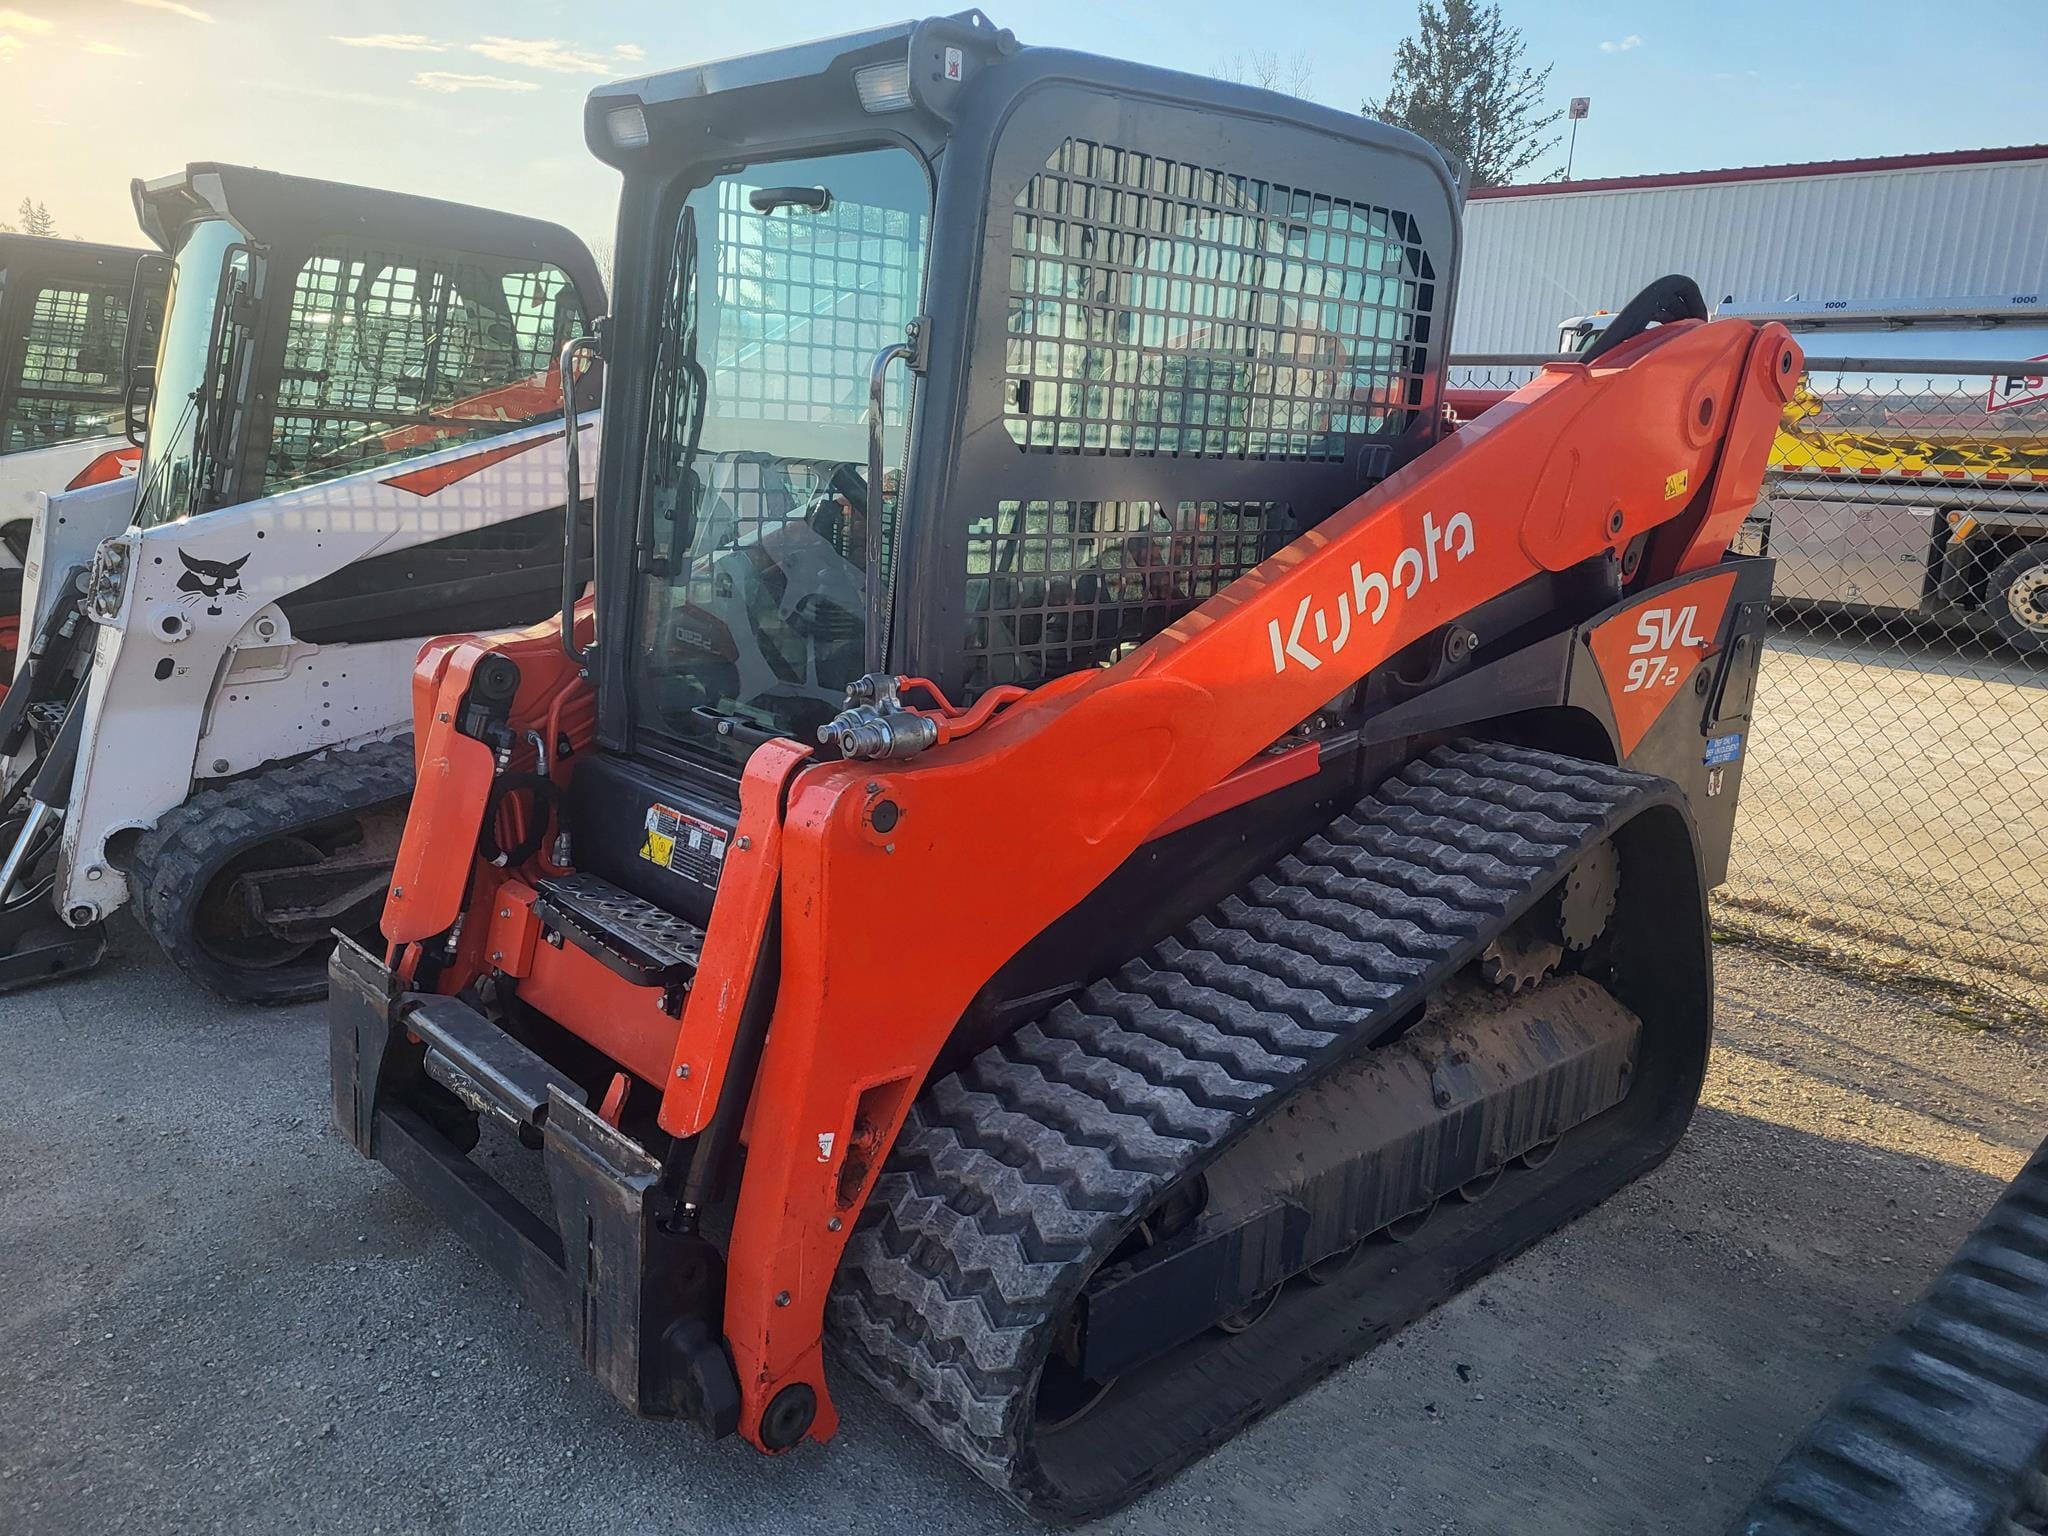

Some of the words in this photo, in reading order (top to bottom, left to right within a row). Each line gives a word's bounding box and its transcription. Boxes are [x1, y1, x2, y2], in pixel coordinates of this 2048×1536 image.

[1824, 301, 1847, 309] 1000
[2011, 296, 2038, 304] 1000
[1267, 511, 1475, 675] Kubota
[1628, 605, 1704, 655] SVL
